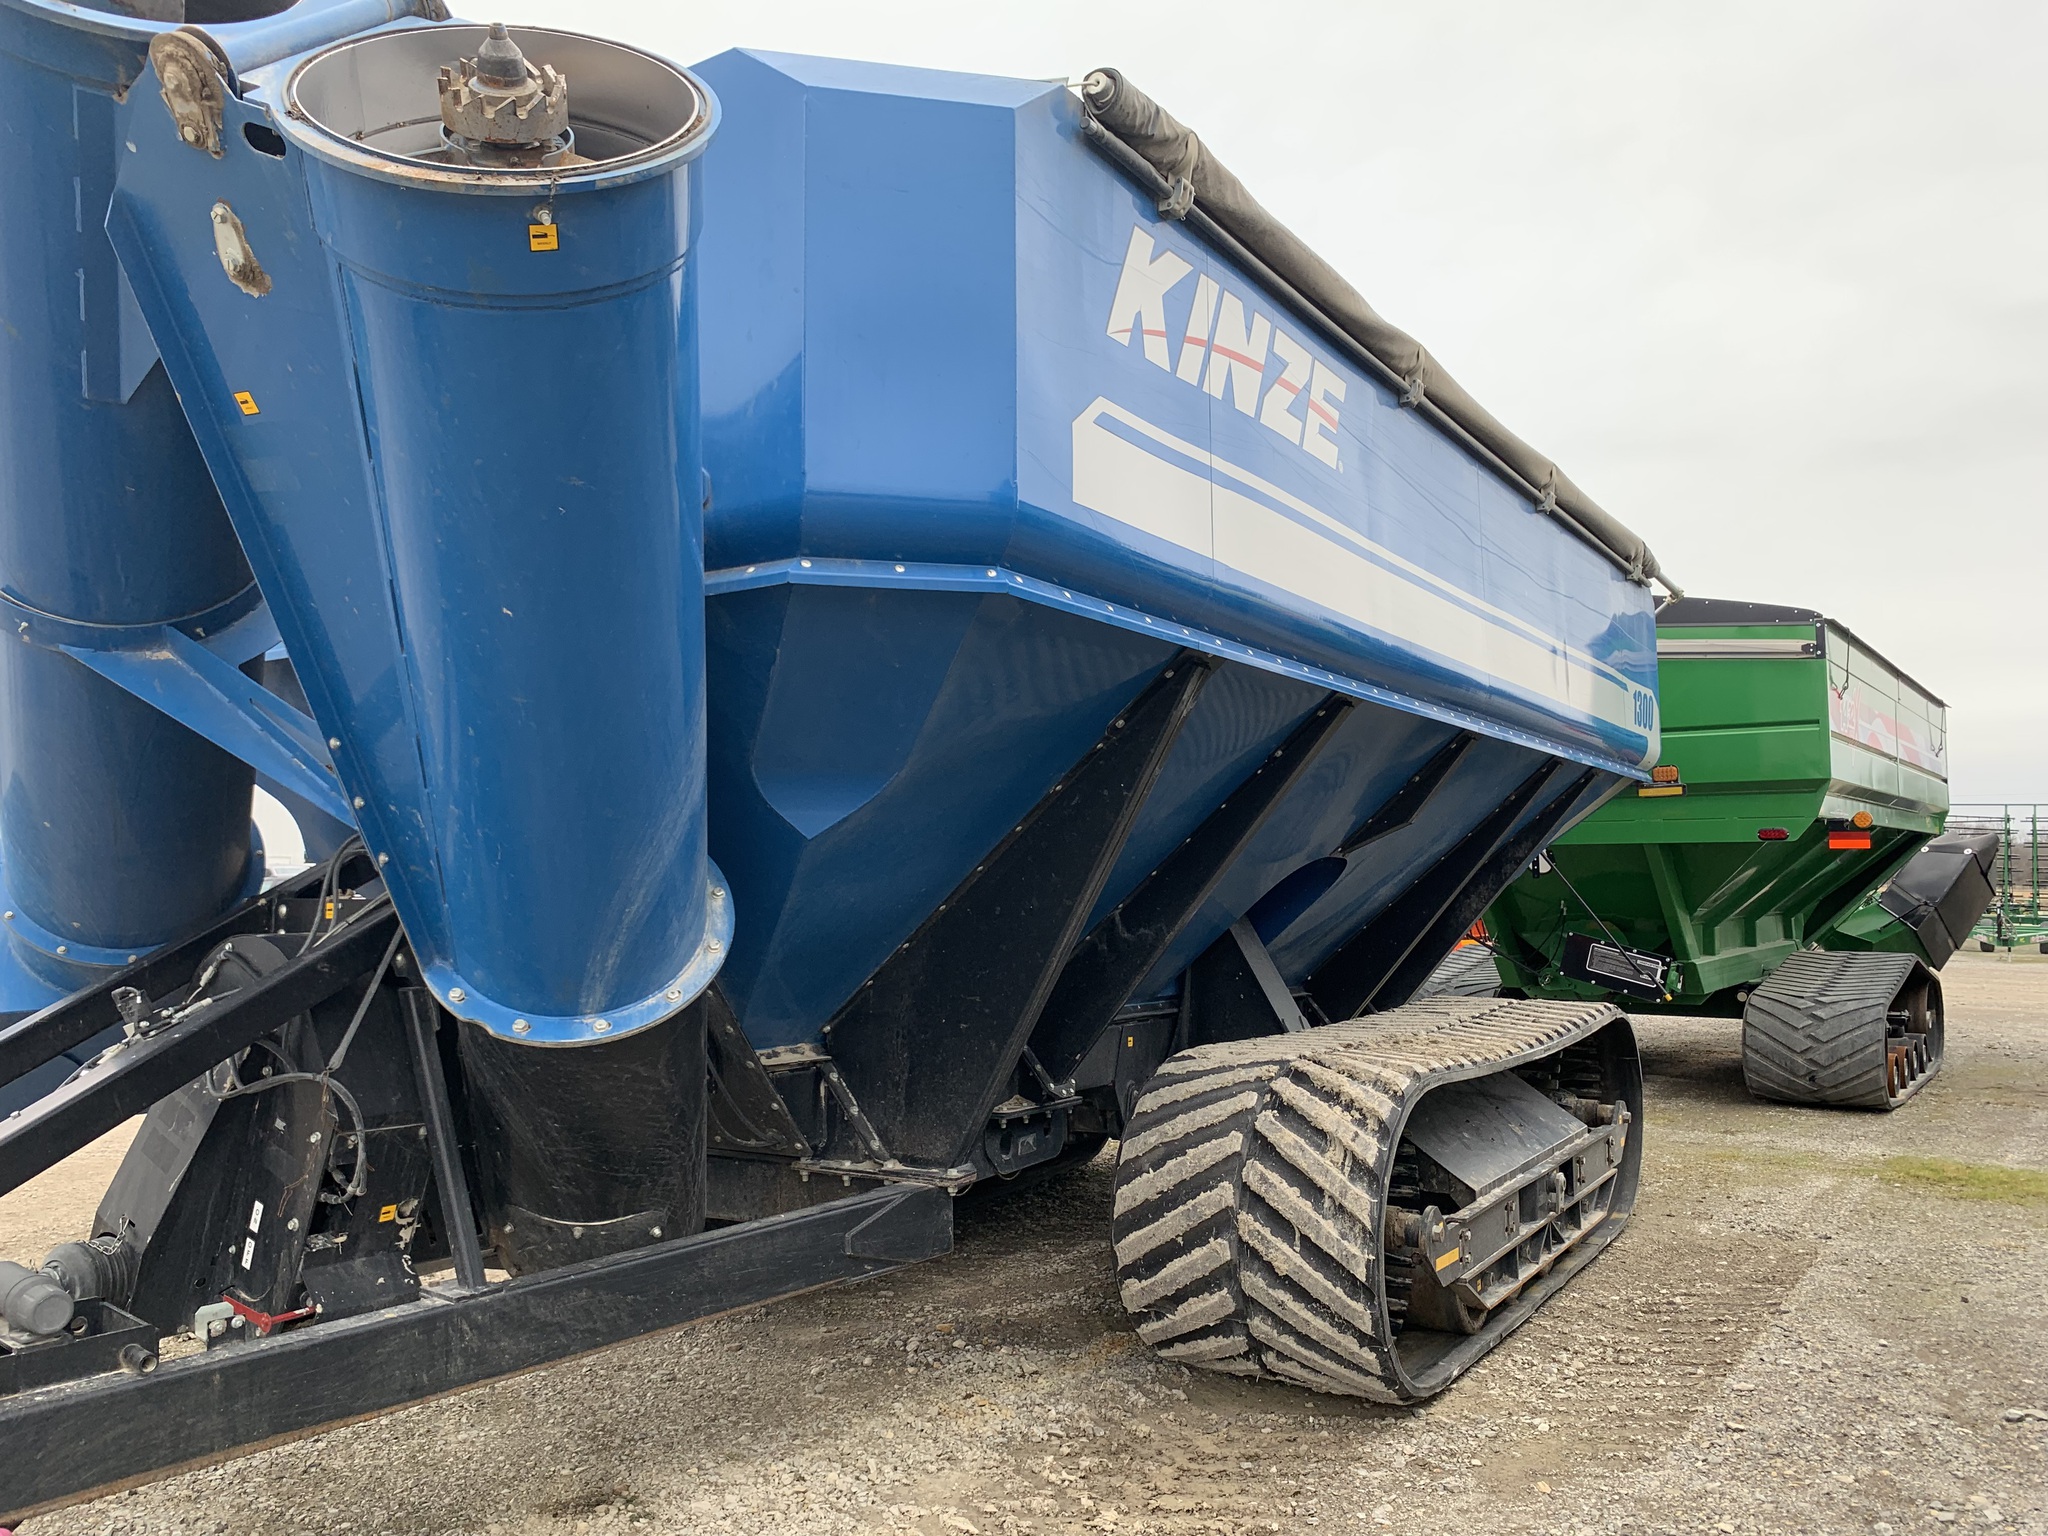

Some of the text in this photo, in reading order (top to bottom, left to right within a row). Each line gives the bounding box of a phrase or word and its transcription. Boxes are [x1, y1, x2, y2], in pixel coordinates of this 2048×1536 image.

[1106, 225, 1346, 470] KINZE
[1633, 690, 1654, 731] 1300
[244, 1241, 253, 1265] OFF
